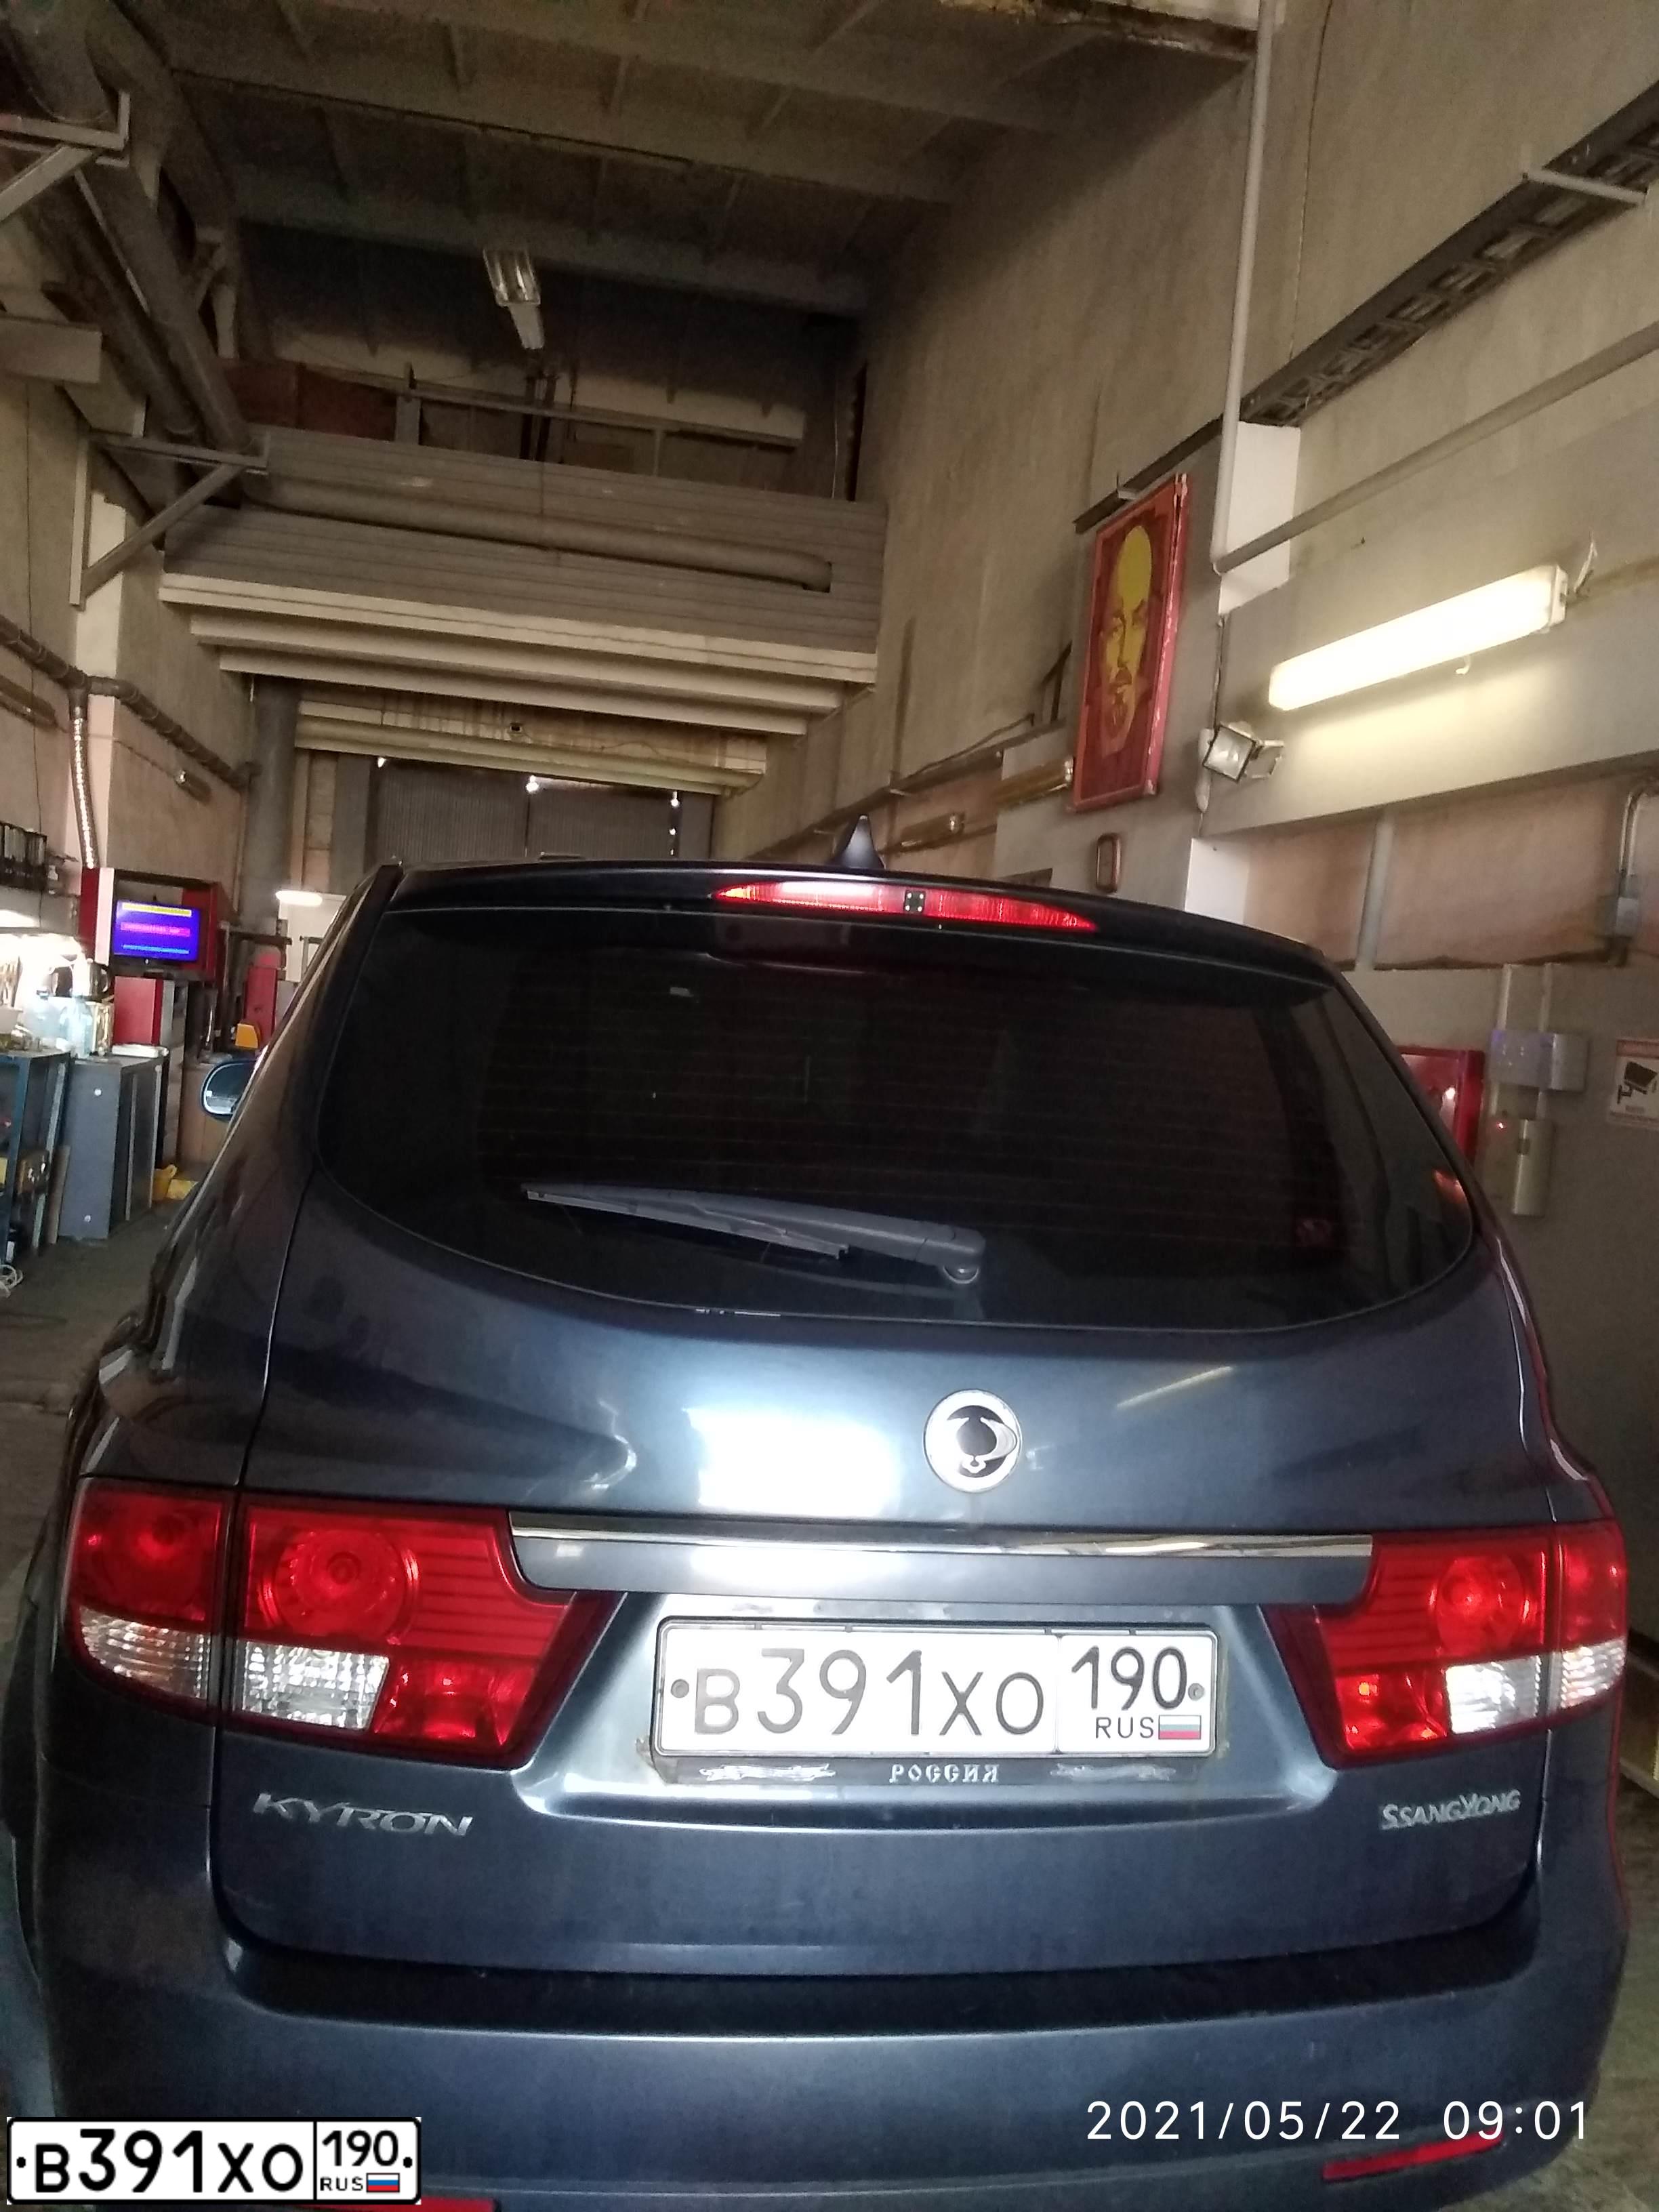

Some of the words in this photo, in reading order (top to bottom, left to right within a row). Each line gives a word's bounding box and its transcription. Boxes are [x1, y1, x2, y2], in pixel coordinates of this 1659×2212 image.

[693, 1647, 1045, 1737] В391ХО
[1071, 1645, 1188, 1711] 190
[1094, 1716, 1155, 1740] RUS
[888, 1763, 1000, 1784] РОССИЯ
[253, 1792, 474, 1837] KYRON
